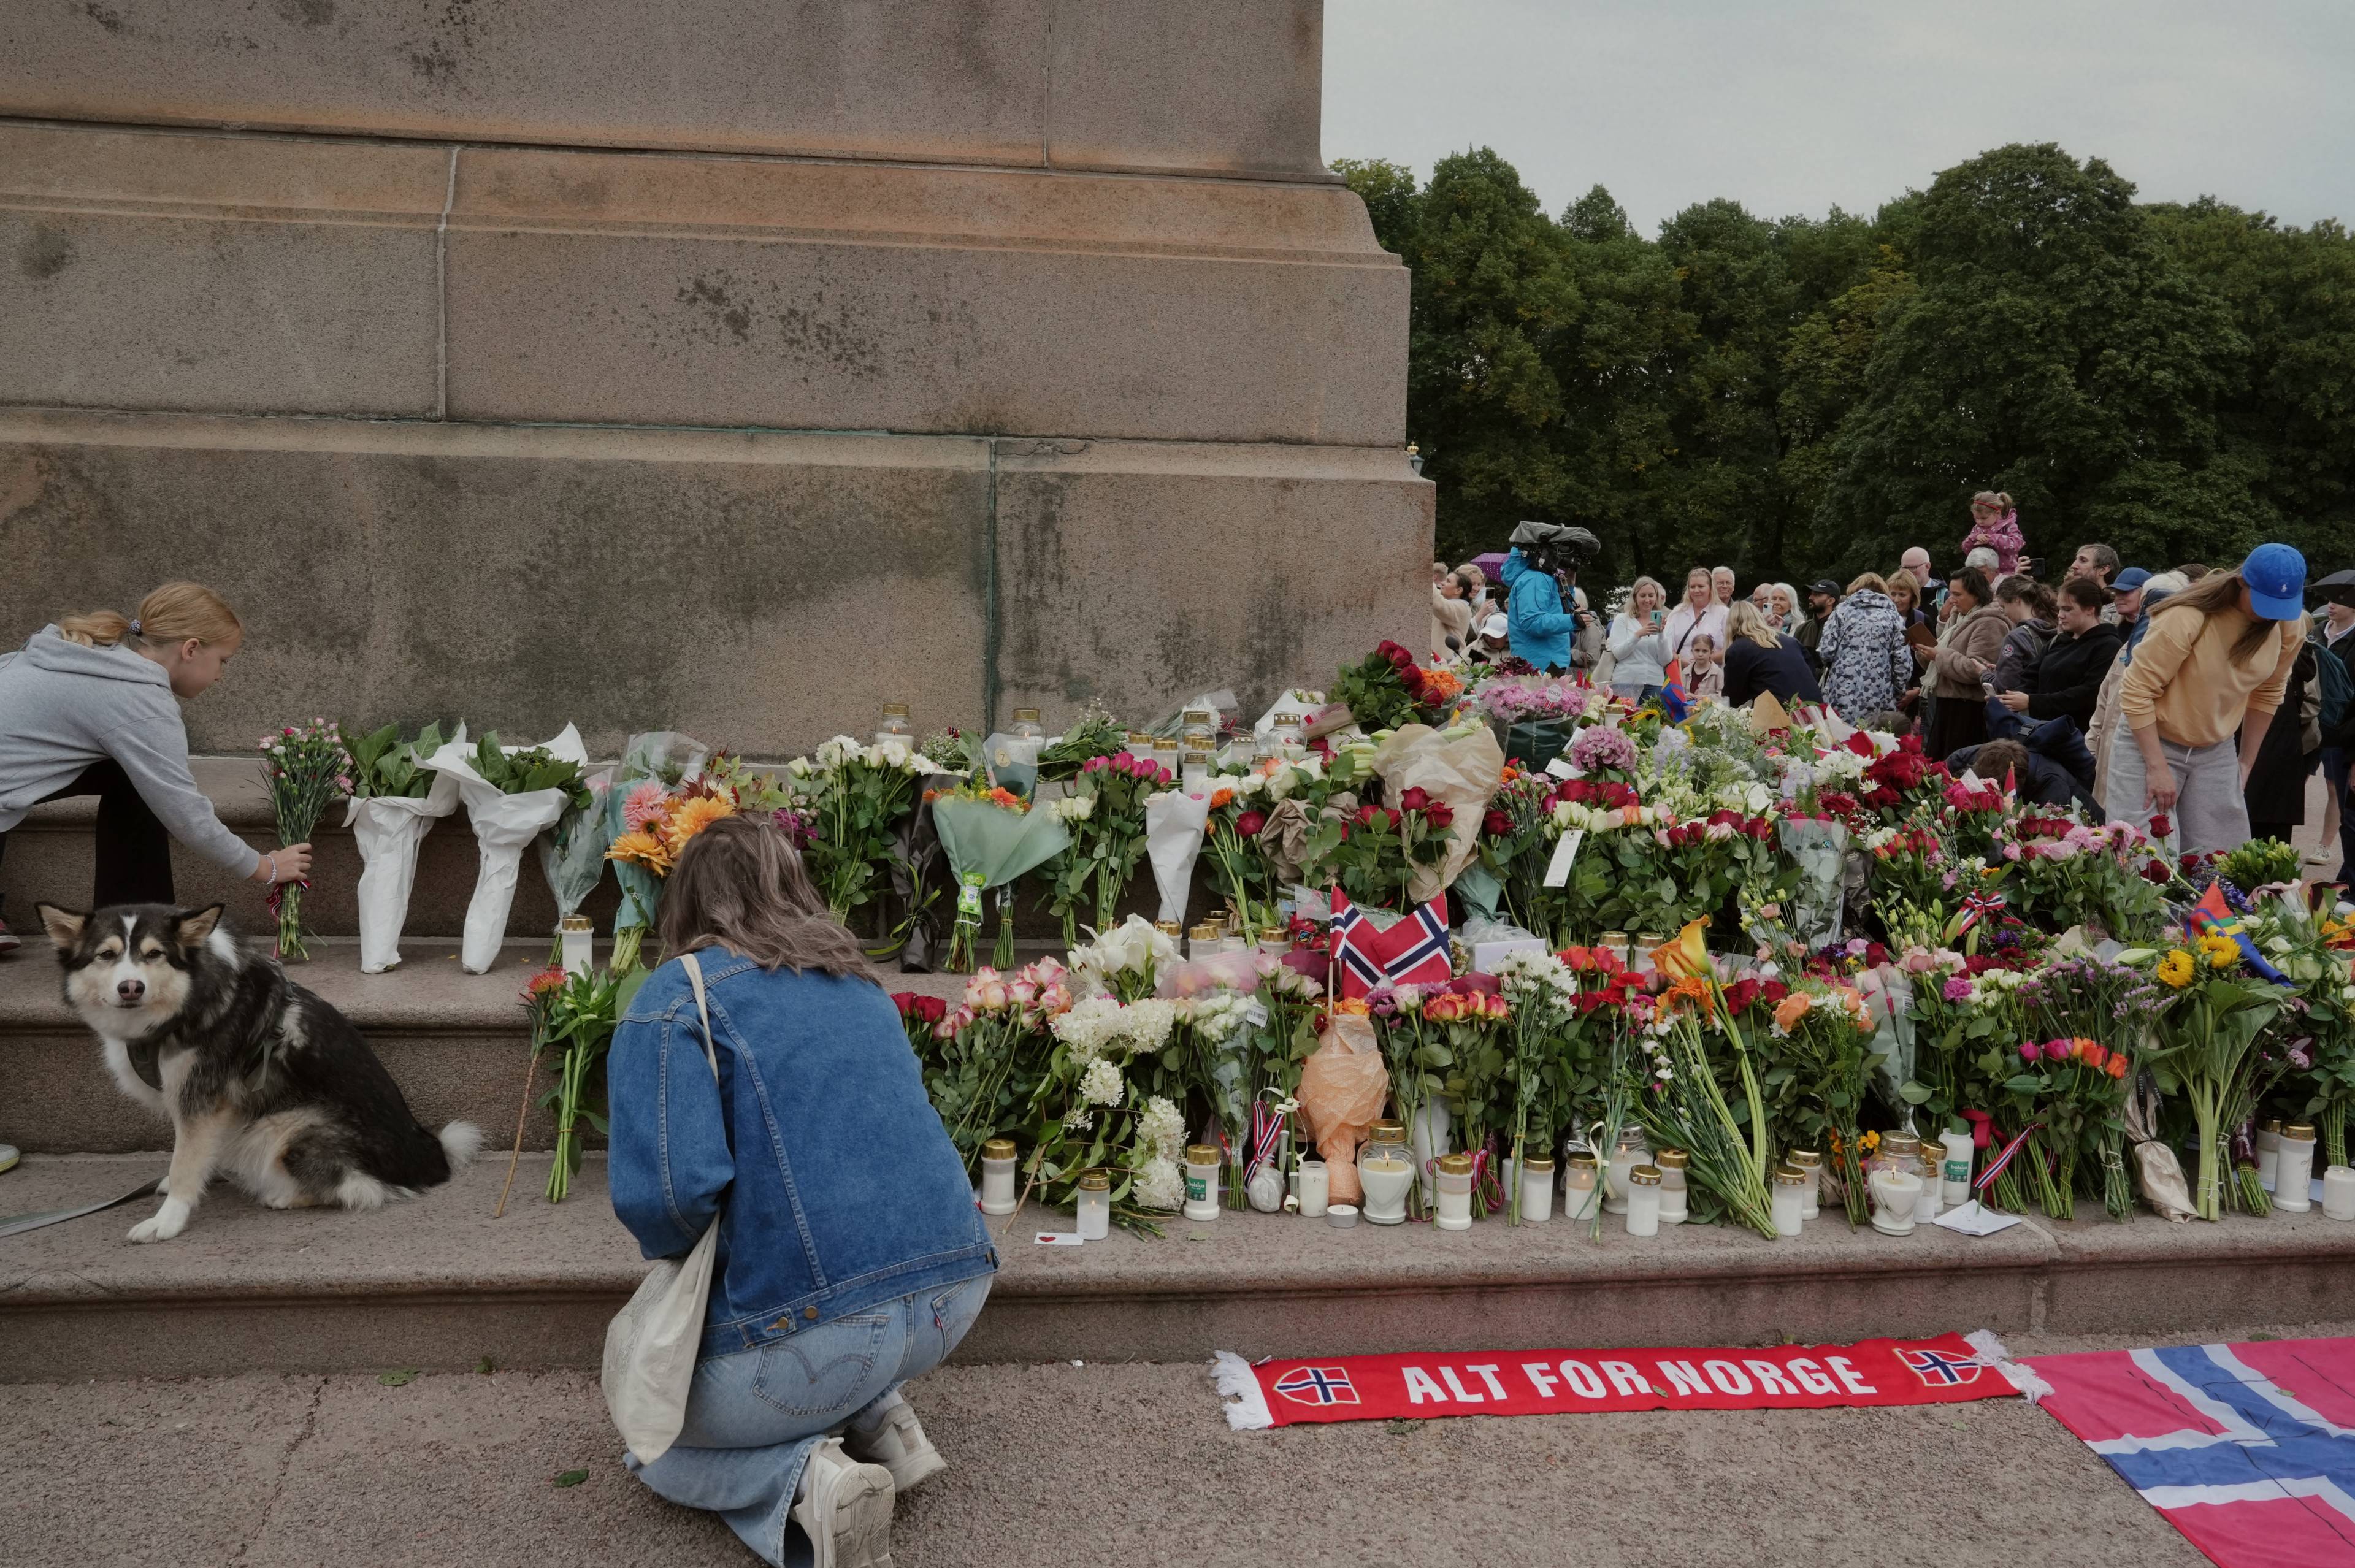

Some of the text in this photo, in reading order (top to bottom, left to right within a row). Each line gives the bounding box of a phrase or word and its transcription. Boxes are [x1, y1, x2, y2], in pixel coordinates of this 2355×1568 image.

[1401, 1356, 1878, 1404] ALT FOR NORGE
